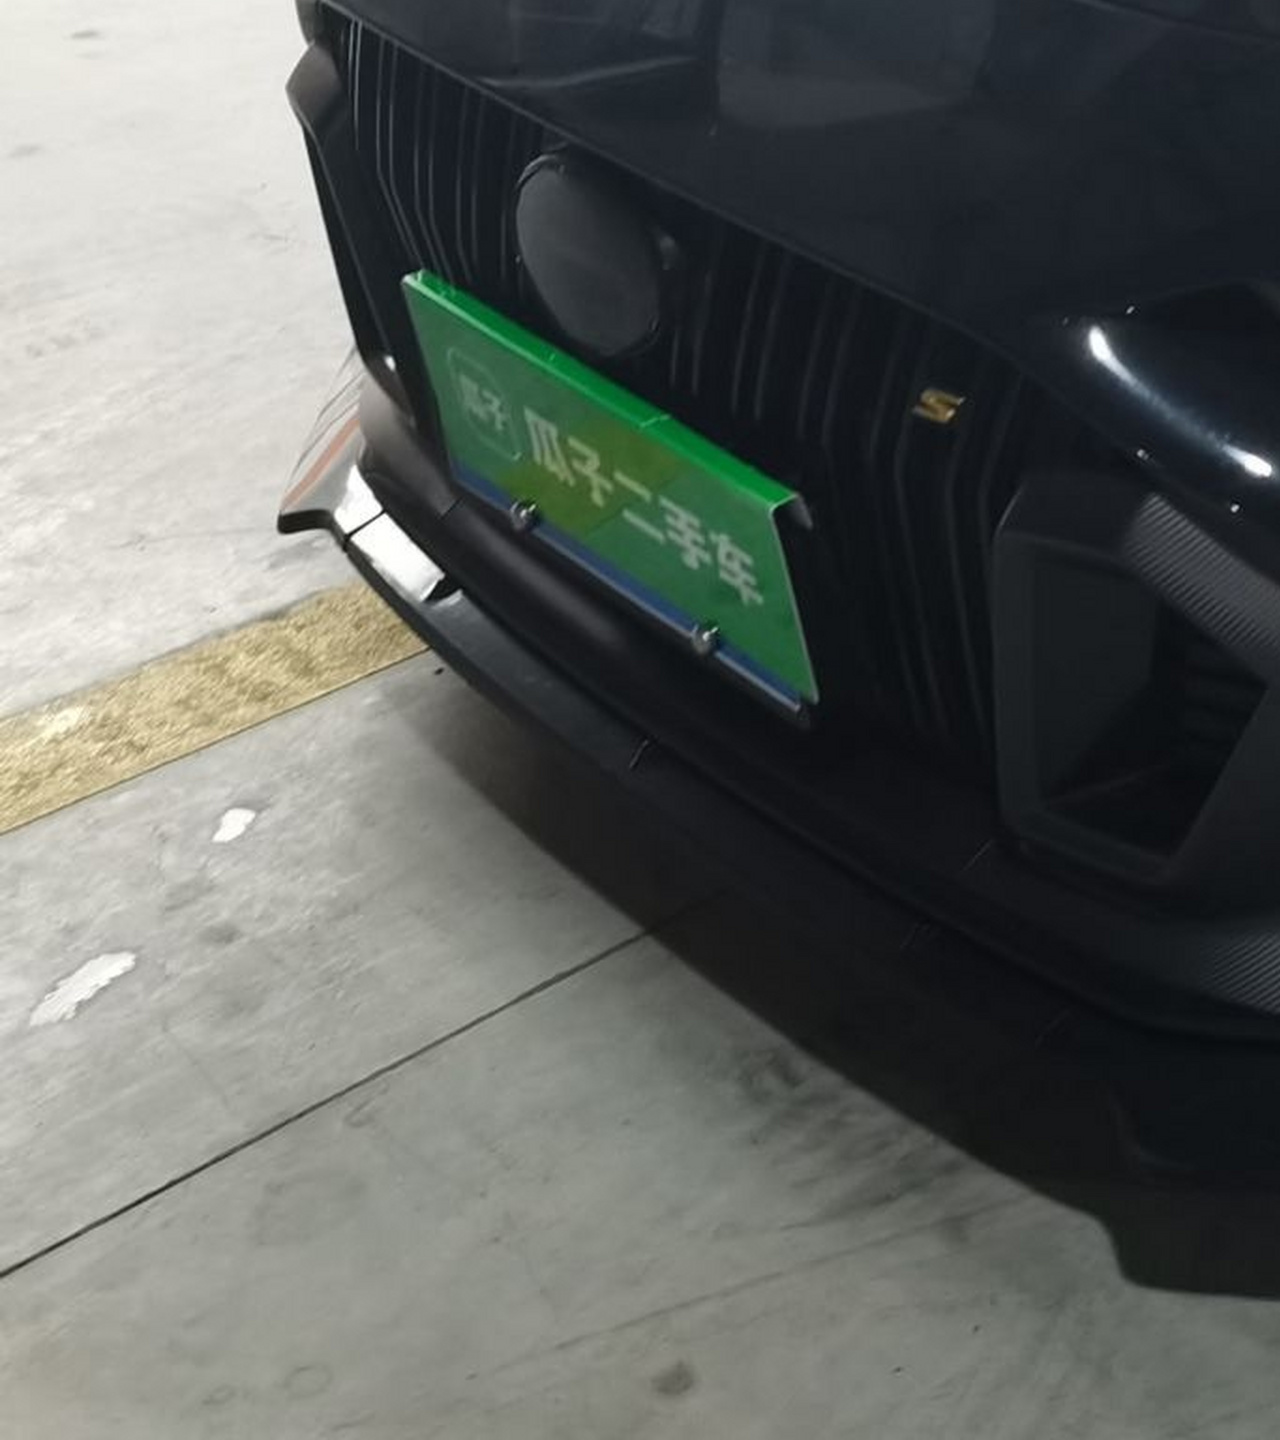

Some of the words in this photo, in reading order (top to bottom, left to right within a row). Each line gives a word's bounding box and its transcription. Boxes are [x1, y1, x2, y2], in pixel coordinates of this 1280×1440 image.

[523, 405, 764, 606] 瓜子二手车
